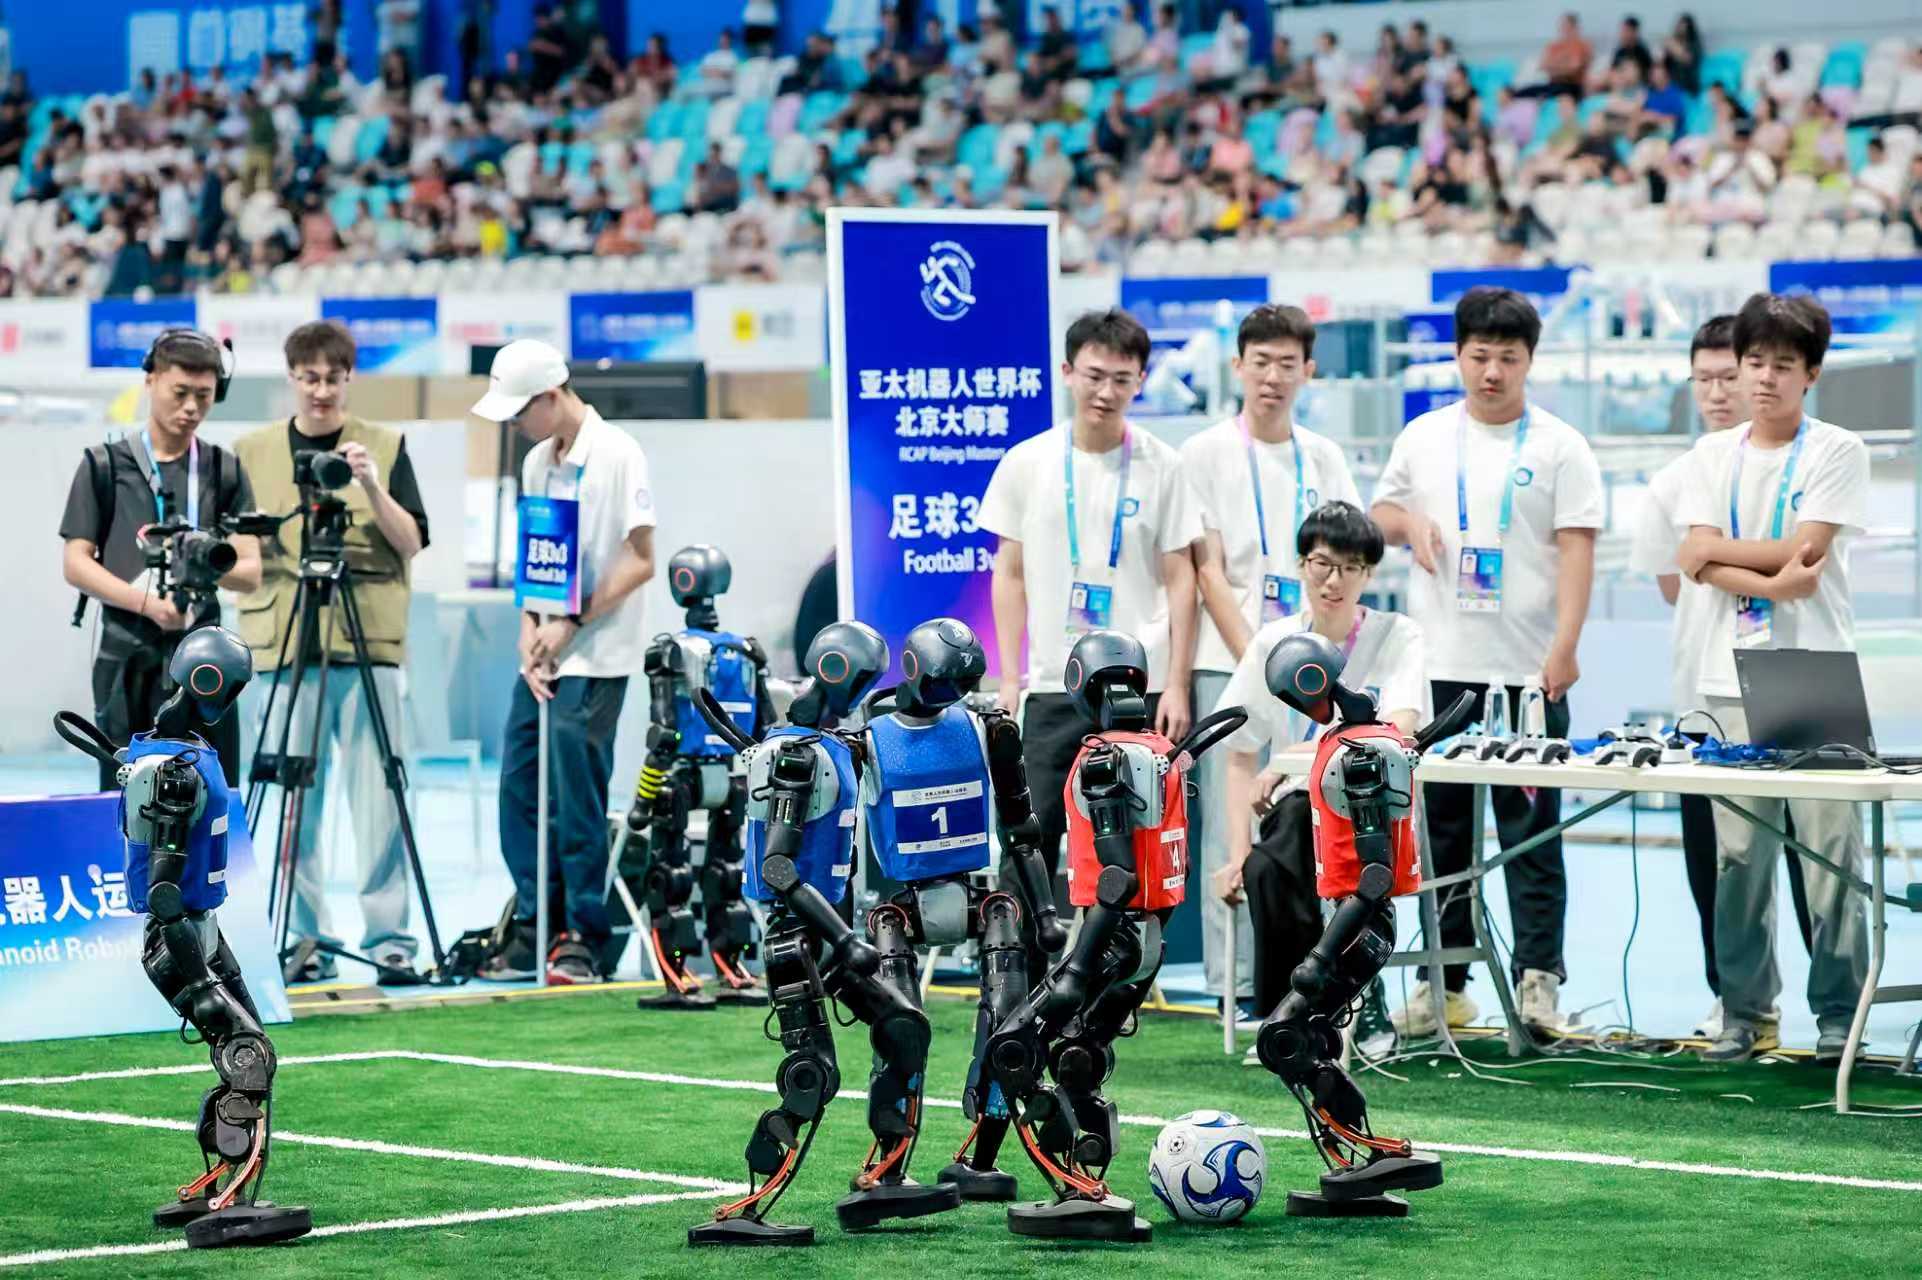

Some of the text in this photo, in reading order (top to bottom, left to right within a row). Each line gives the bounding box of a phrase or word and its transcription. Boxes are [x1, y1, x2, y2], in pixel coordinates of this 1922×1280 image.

[860, 367, 1042, 399] 亚太机器人世界杯
[895, 405, 1008, 436] 北京大师赛
[904, 548, 974, 573] Football
[931, 806, 948, 834] 1
[0, 863, 134, 926] 器人运
